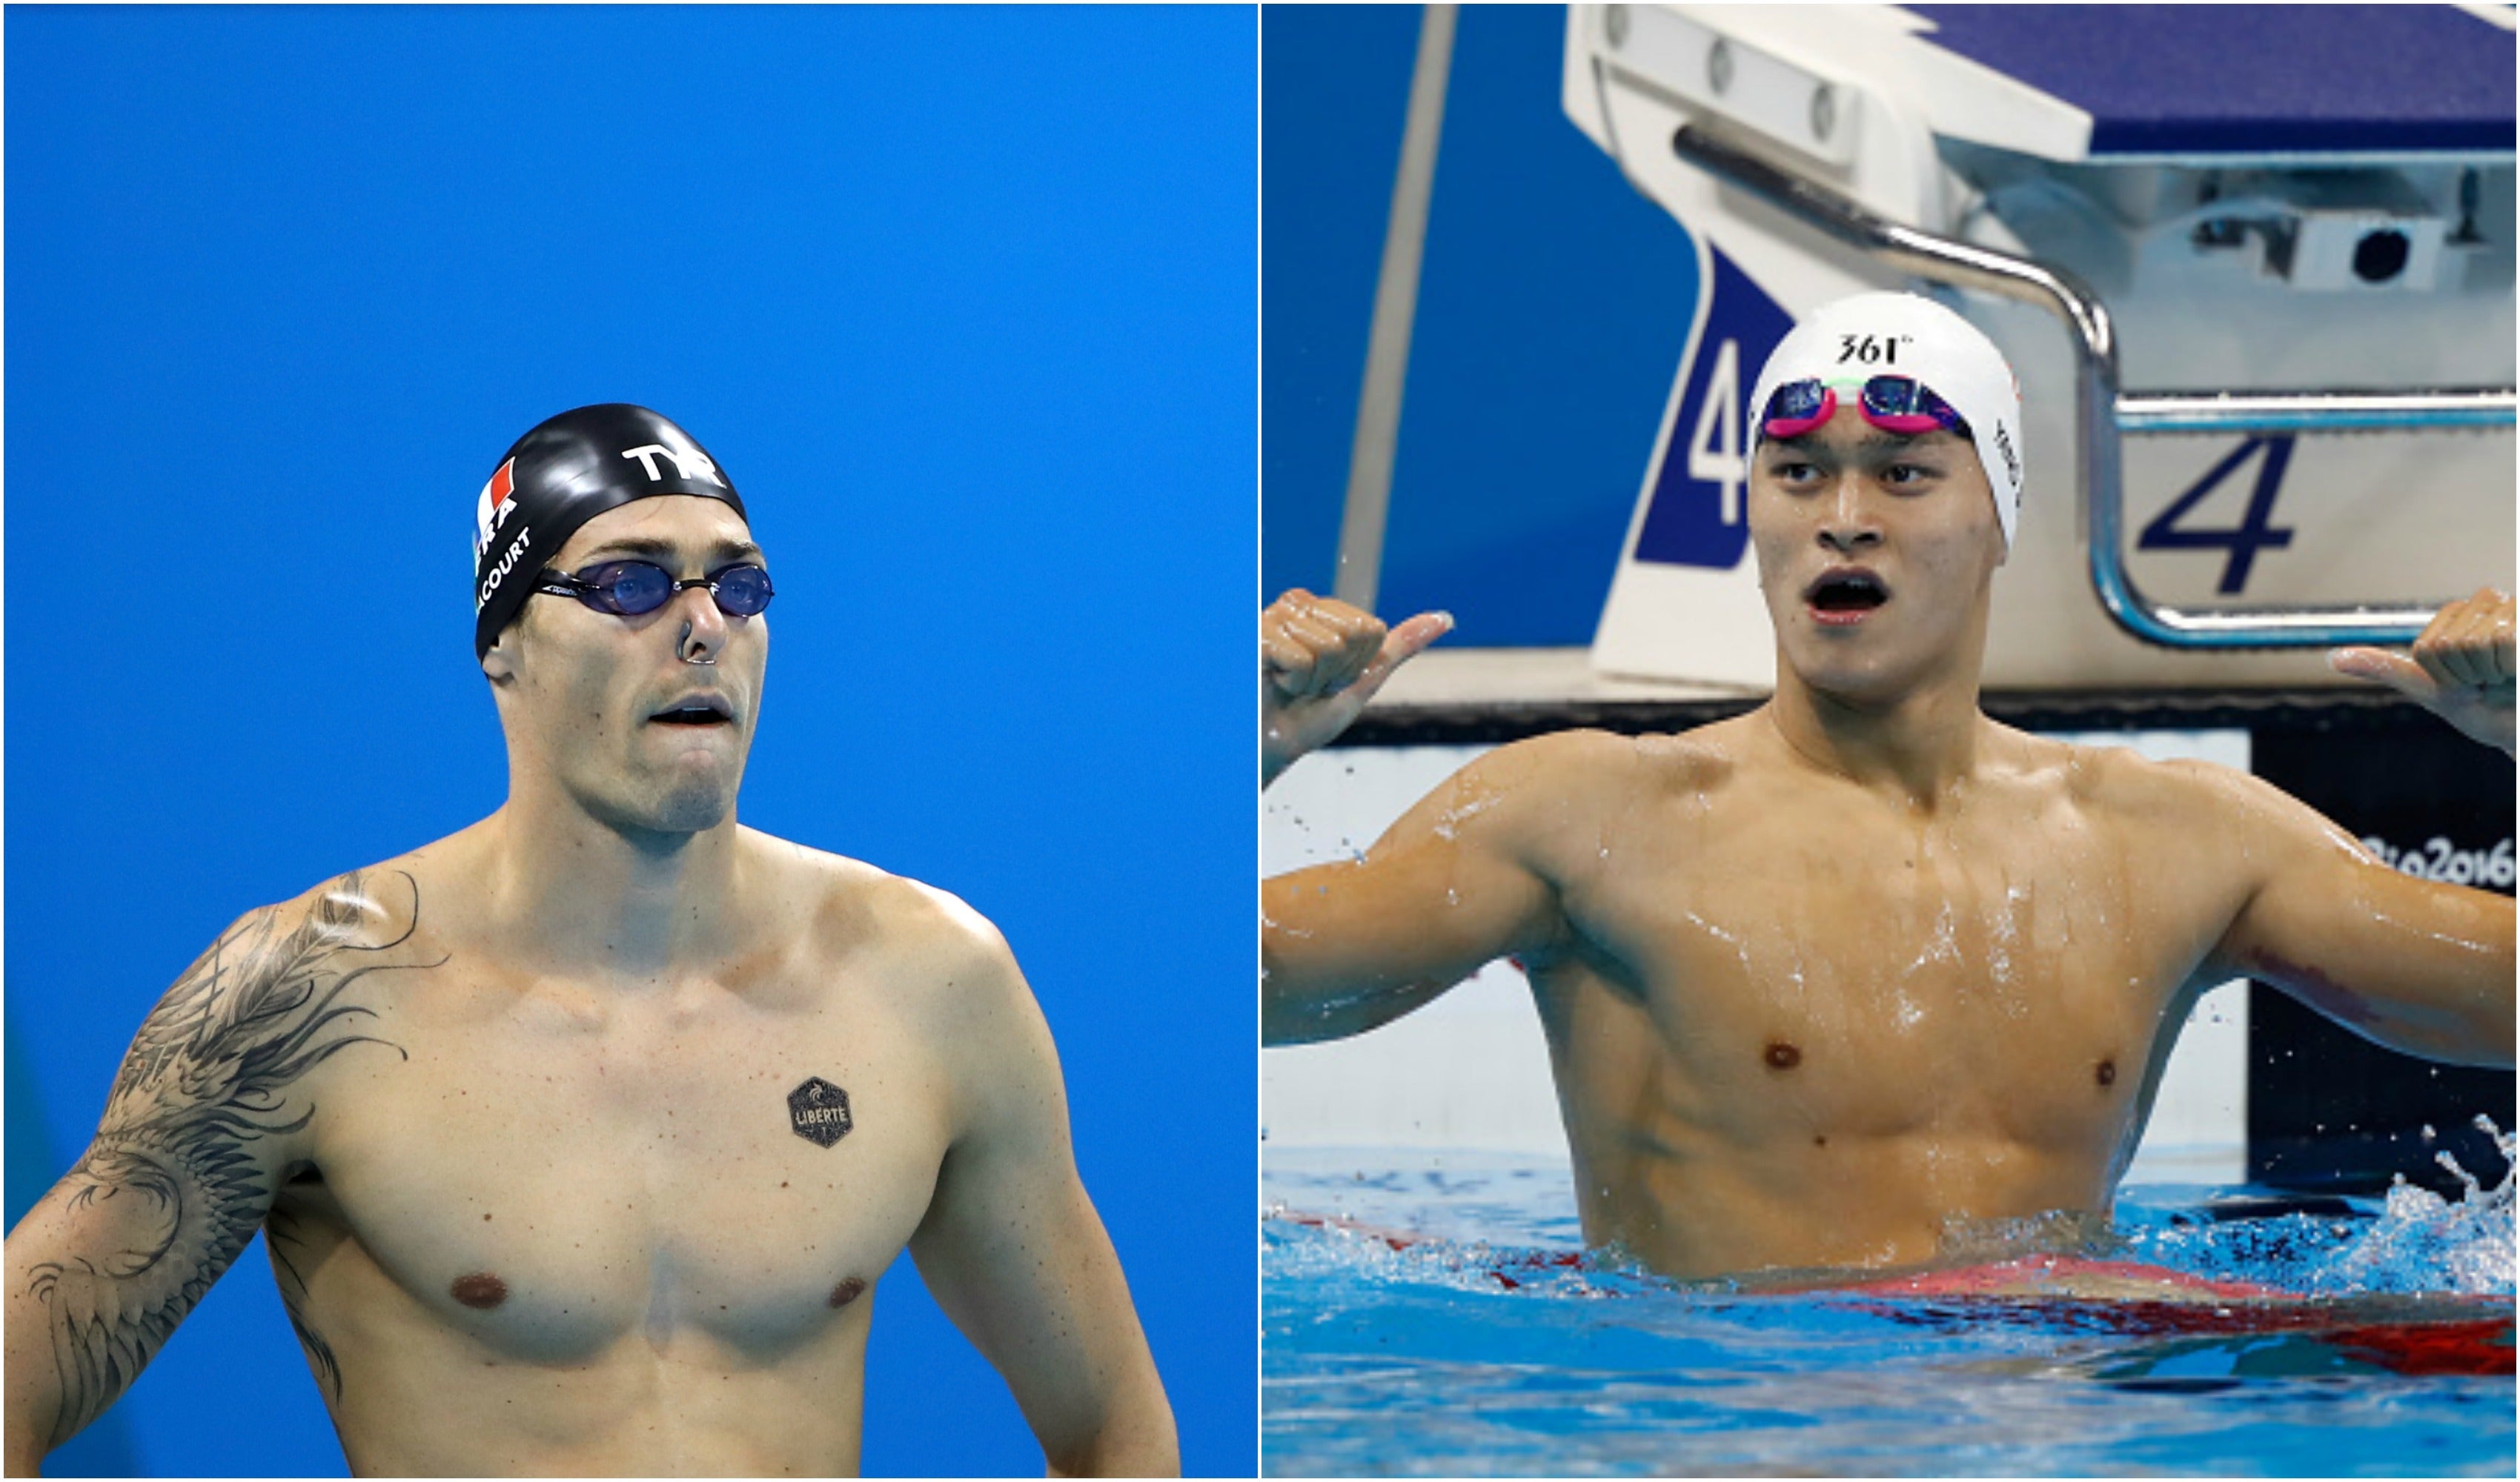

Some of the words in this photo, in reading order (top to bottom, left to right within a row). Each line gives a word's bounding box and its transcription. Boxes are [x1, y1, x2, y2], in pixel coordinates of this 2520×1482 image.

[621, 444, 727, 489] TYR
[1688, 339, 1748, 525] 4
[2136, 430, 2297, 596] 4
